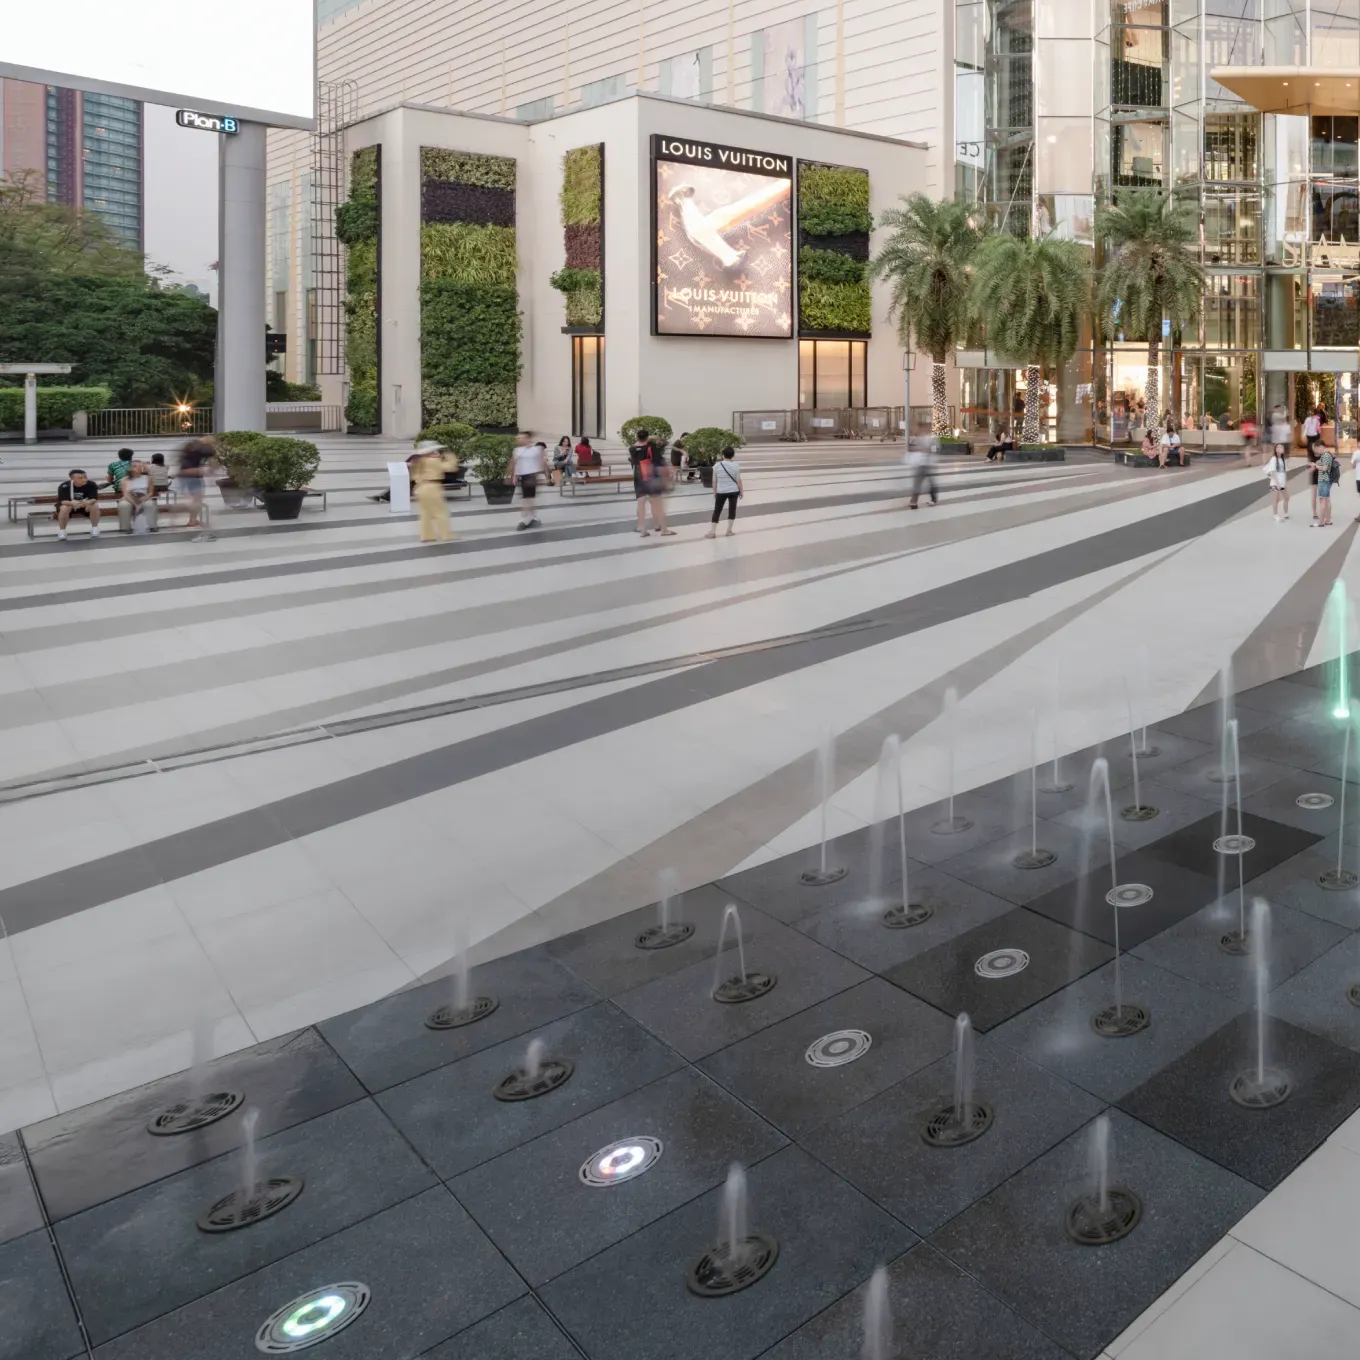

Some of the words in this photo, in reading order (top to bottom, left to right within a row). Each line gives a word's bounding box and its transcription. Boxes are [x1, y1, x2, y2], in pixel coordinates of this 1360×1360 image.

[661, 139, 713, 160] LOUIS
[718, 148, 788, 173] VUITTON
[672, 286, 717, 302] LOUIS
[719, 289, 778, 305] VUITTON
